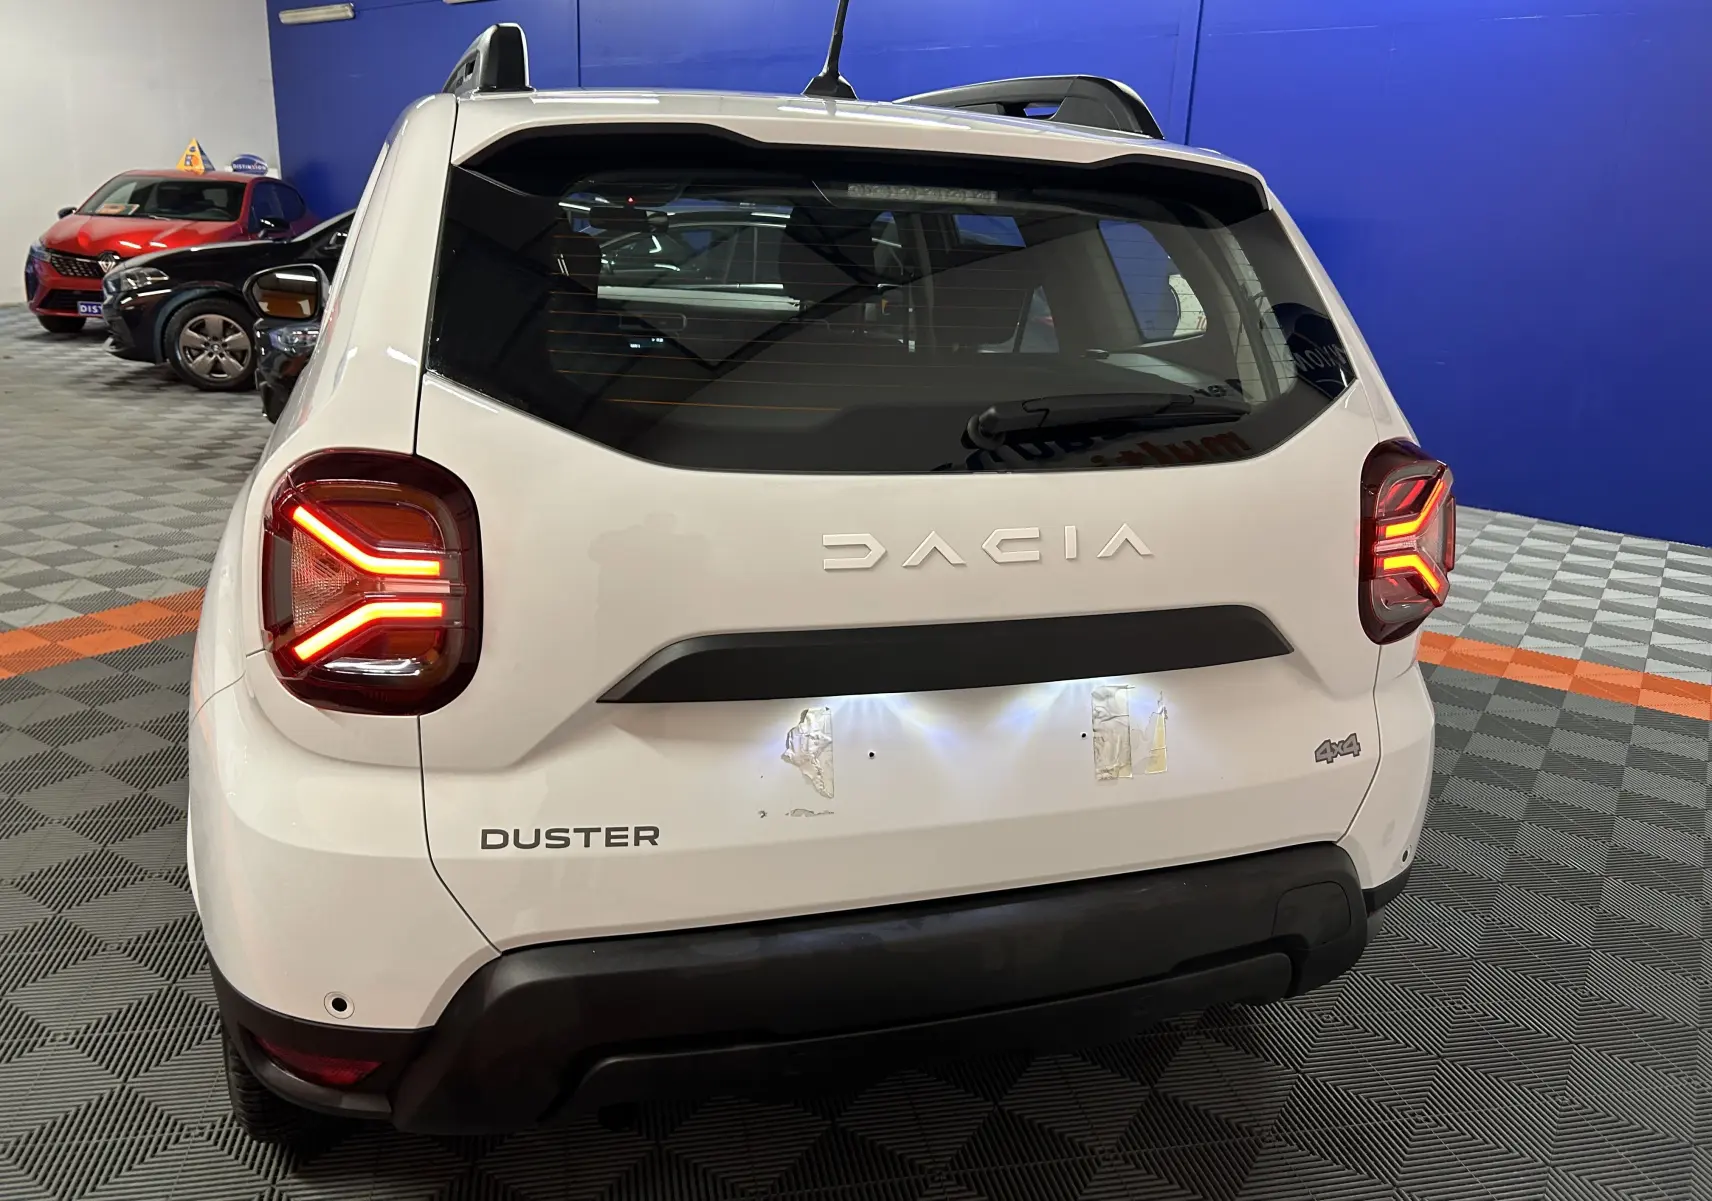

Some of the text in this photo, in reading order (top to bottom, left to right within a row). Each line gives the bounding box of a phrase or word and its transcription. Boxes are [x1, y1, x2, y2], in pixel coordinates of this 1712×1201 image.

[822, 523, 1154, 570] DACIA
[1314, 732, 1361, 764] 4x4
[481, 826, 659, 850] DUSTER
